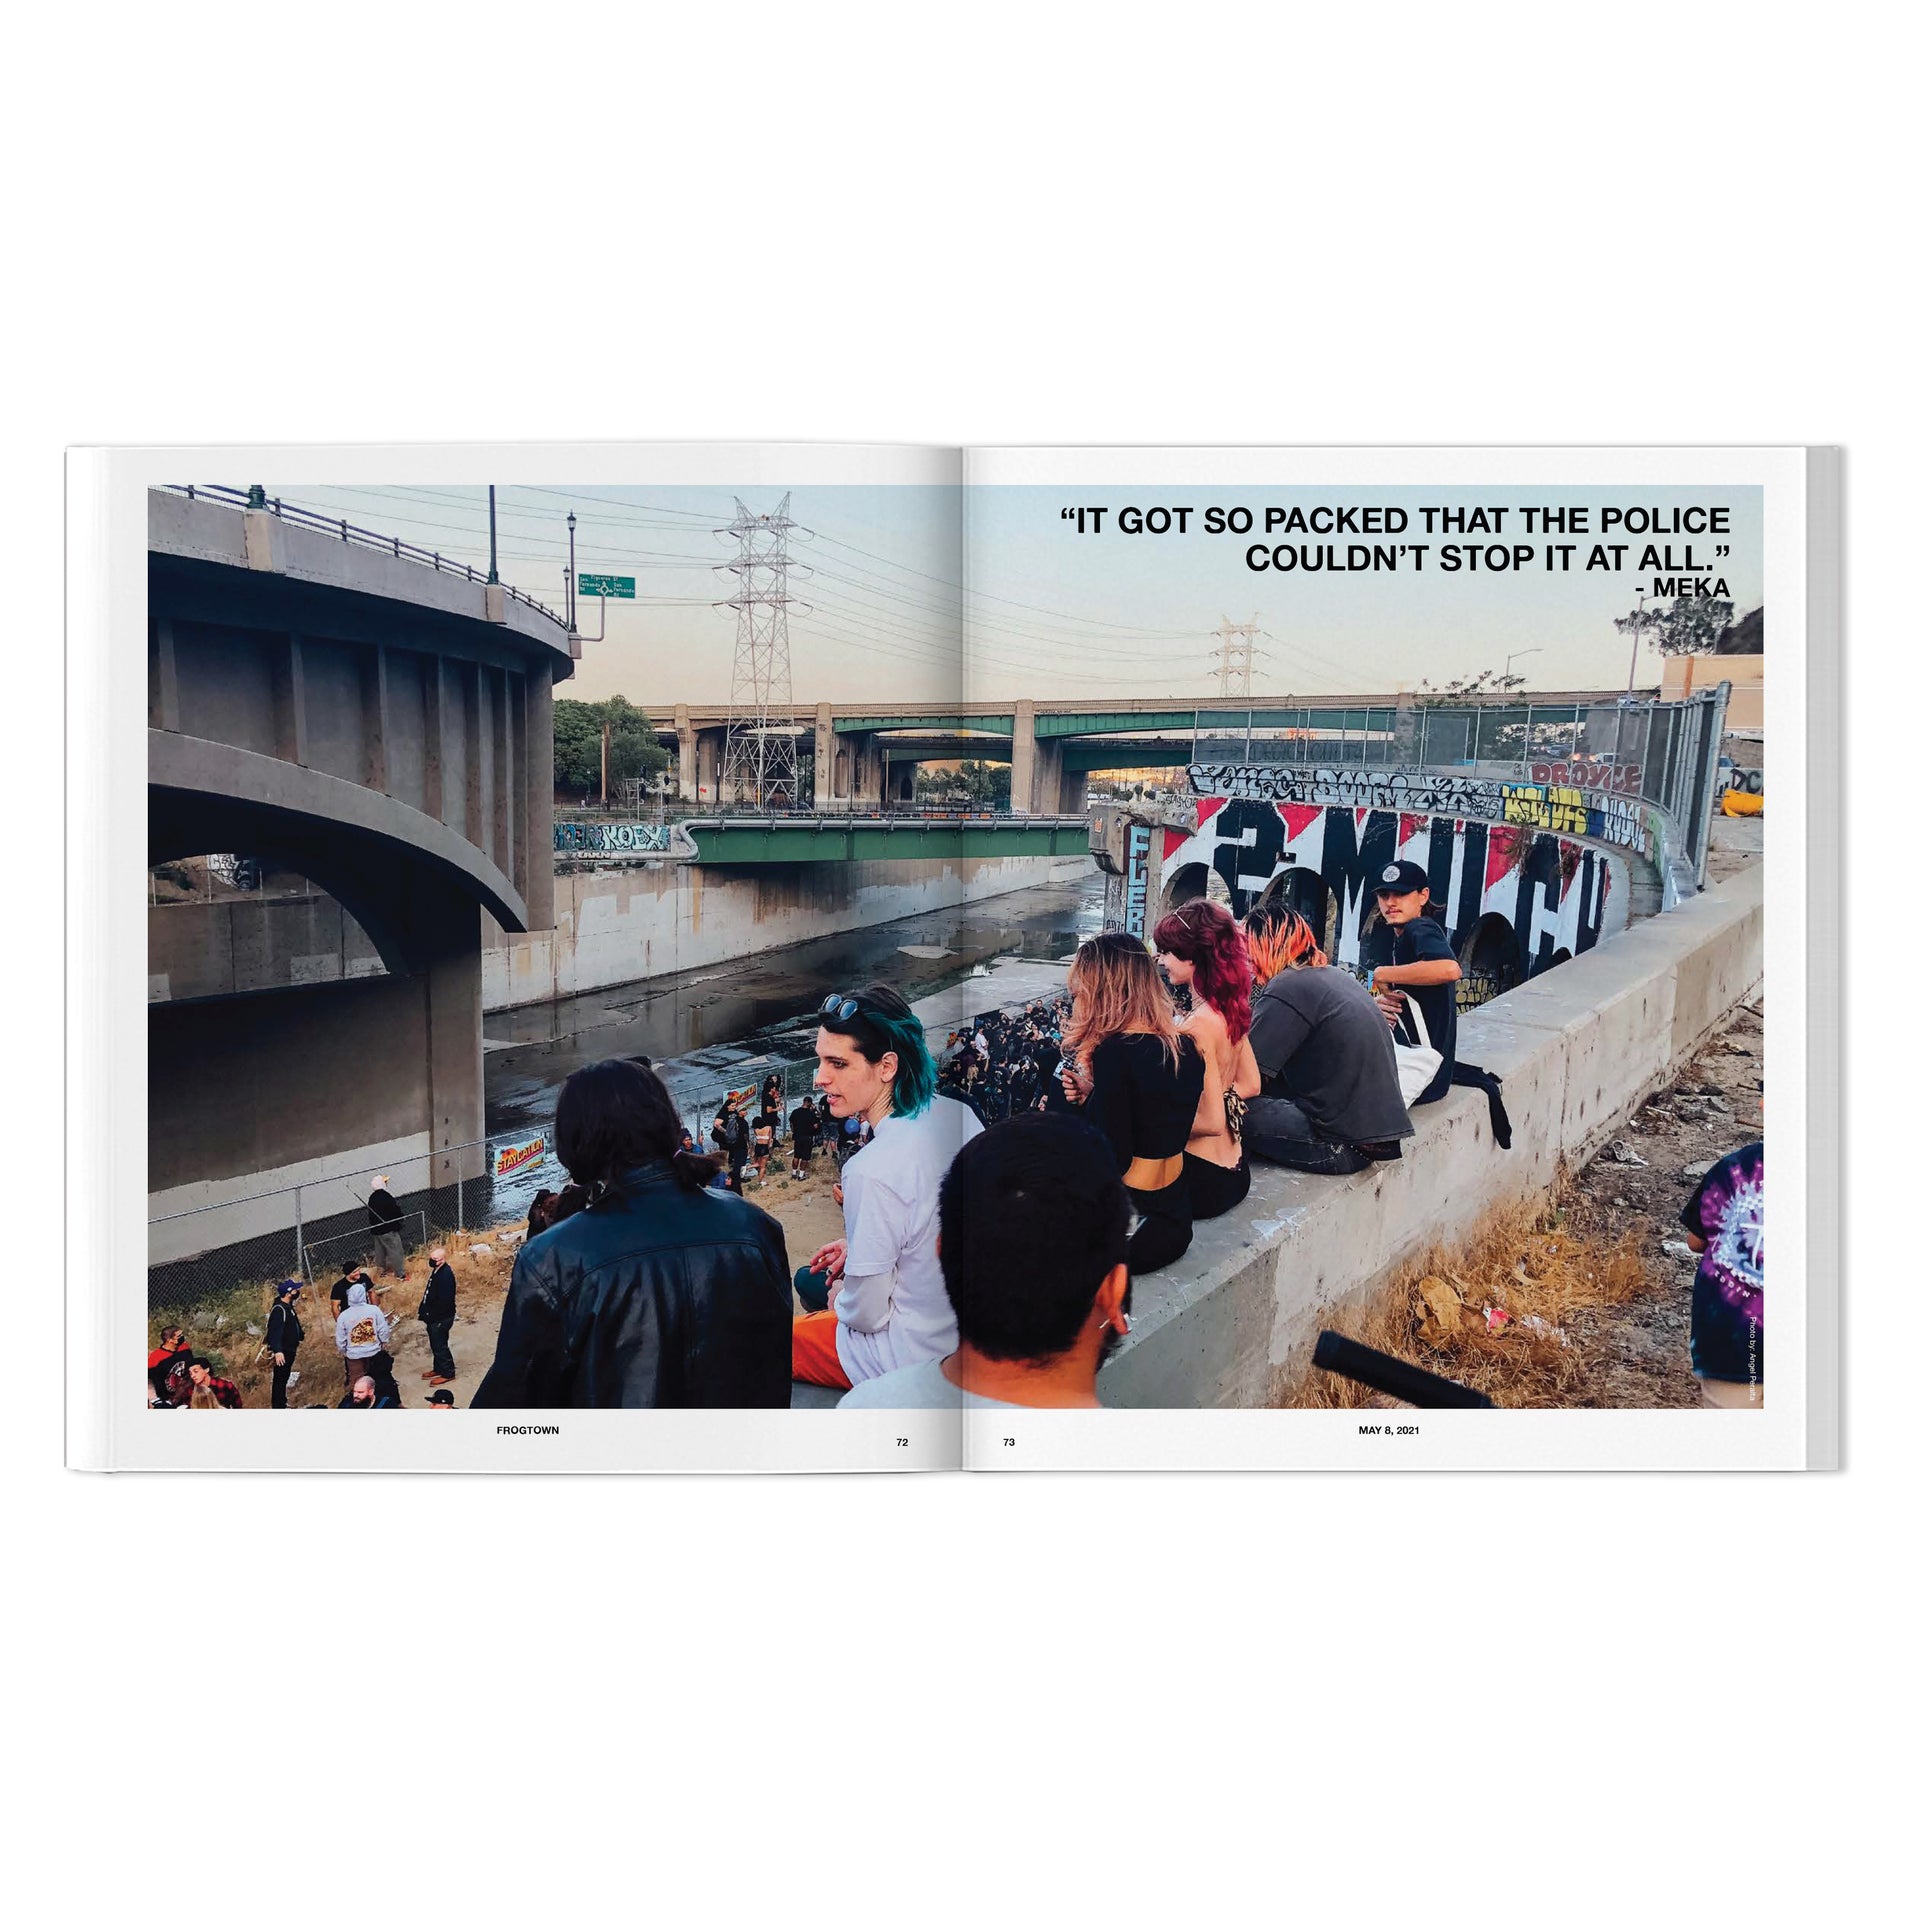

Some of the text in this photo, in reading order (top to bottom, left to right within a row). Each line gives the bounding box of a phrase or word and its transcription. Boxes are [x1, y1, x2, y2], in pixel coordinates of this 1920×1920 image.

[1061, 506, 1731, 535] “IT GOT SO PACKED THAT THE POLICE
[1245, 544, 1730, 572] COULDN’T STOP IT AT ALL.”
[1654, 578, 1731, 598] MEKA
[496, 1425, 560, 1435] FROGTOWN
[1358, 1425, 1419, 1436] MAY 8, 2021
[896, 1438, 909, 1447] 72
[1003, 1437, 1016, 1447] 73
